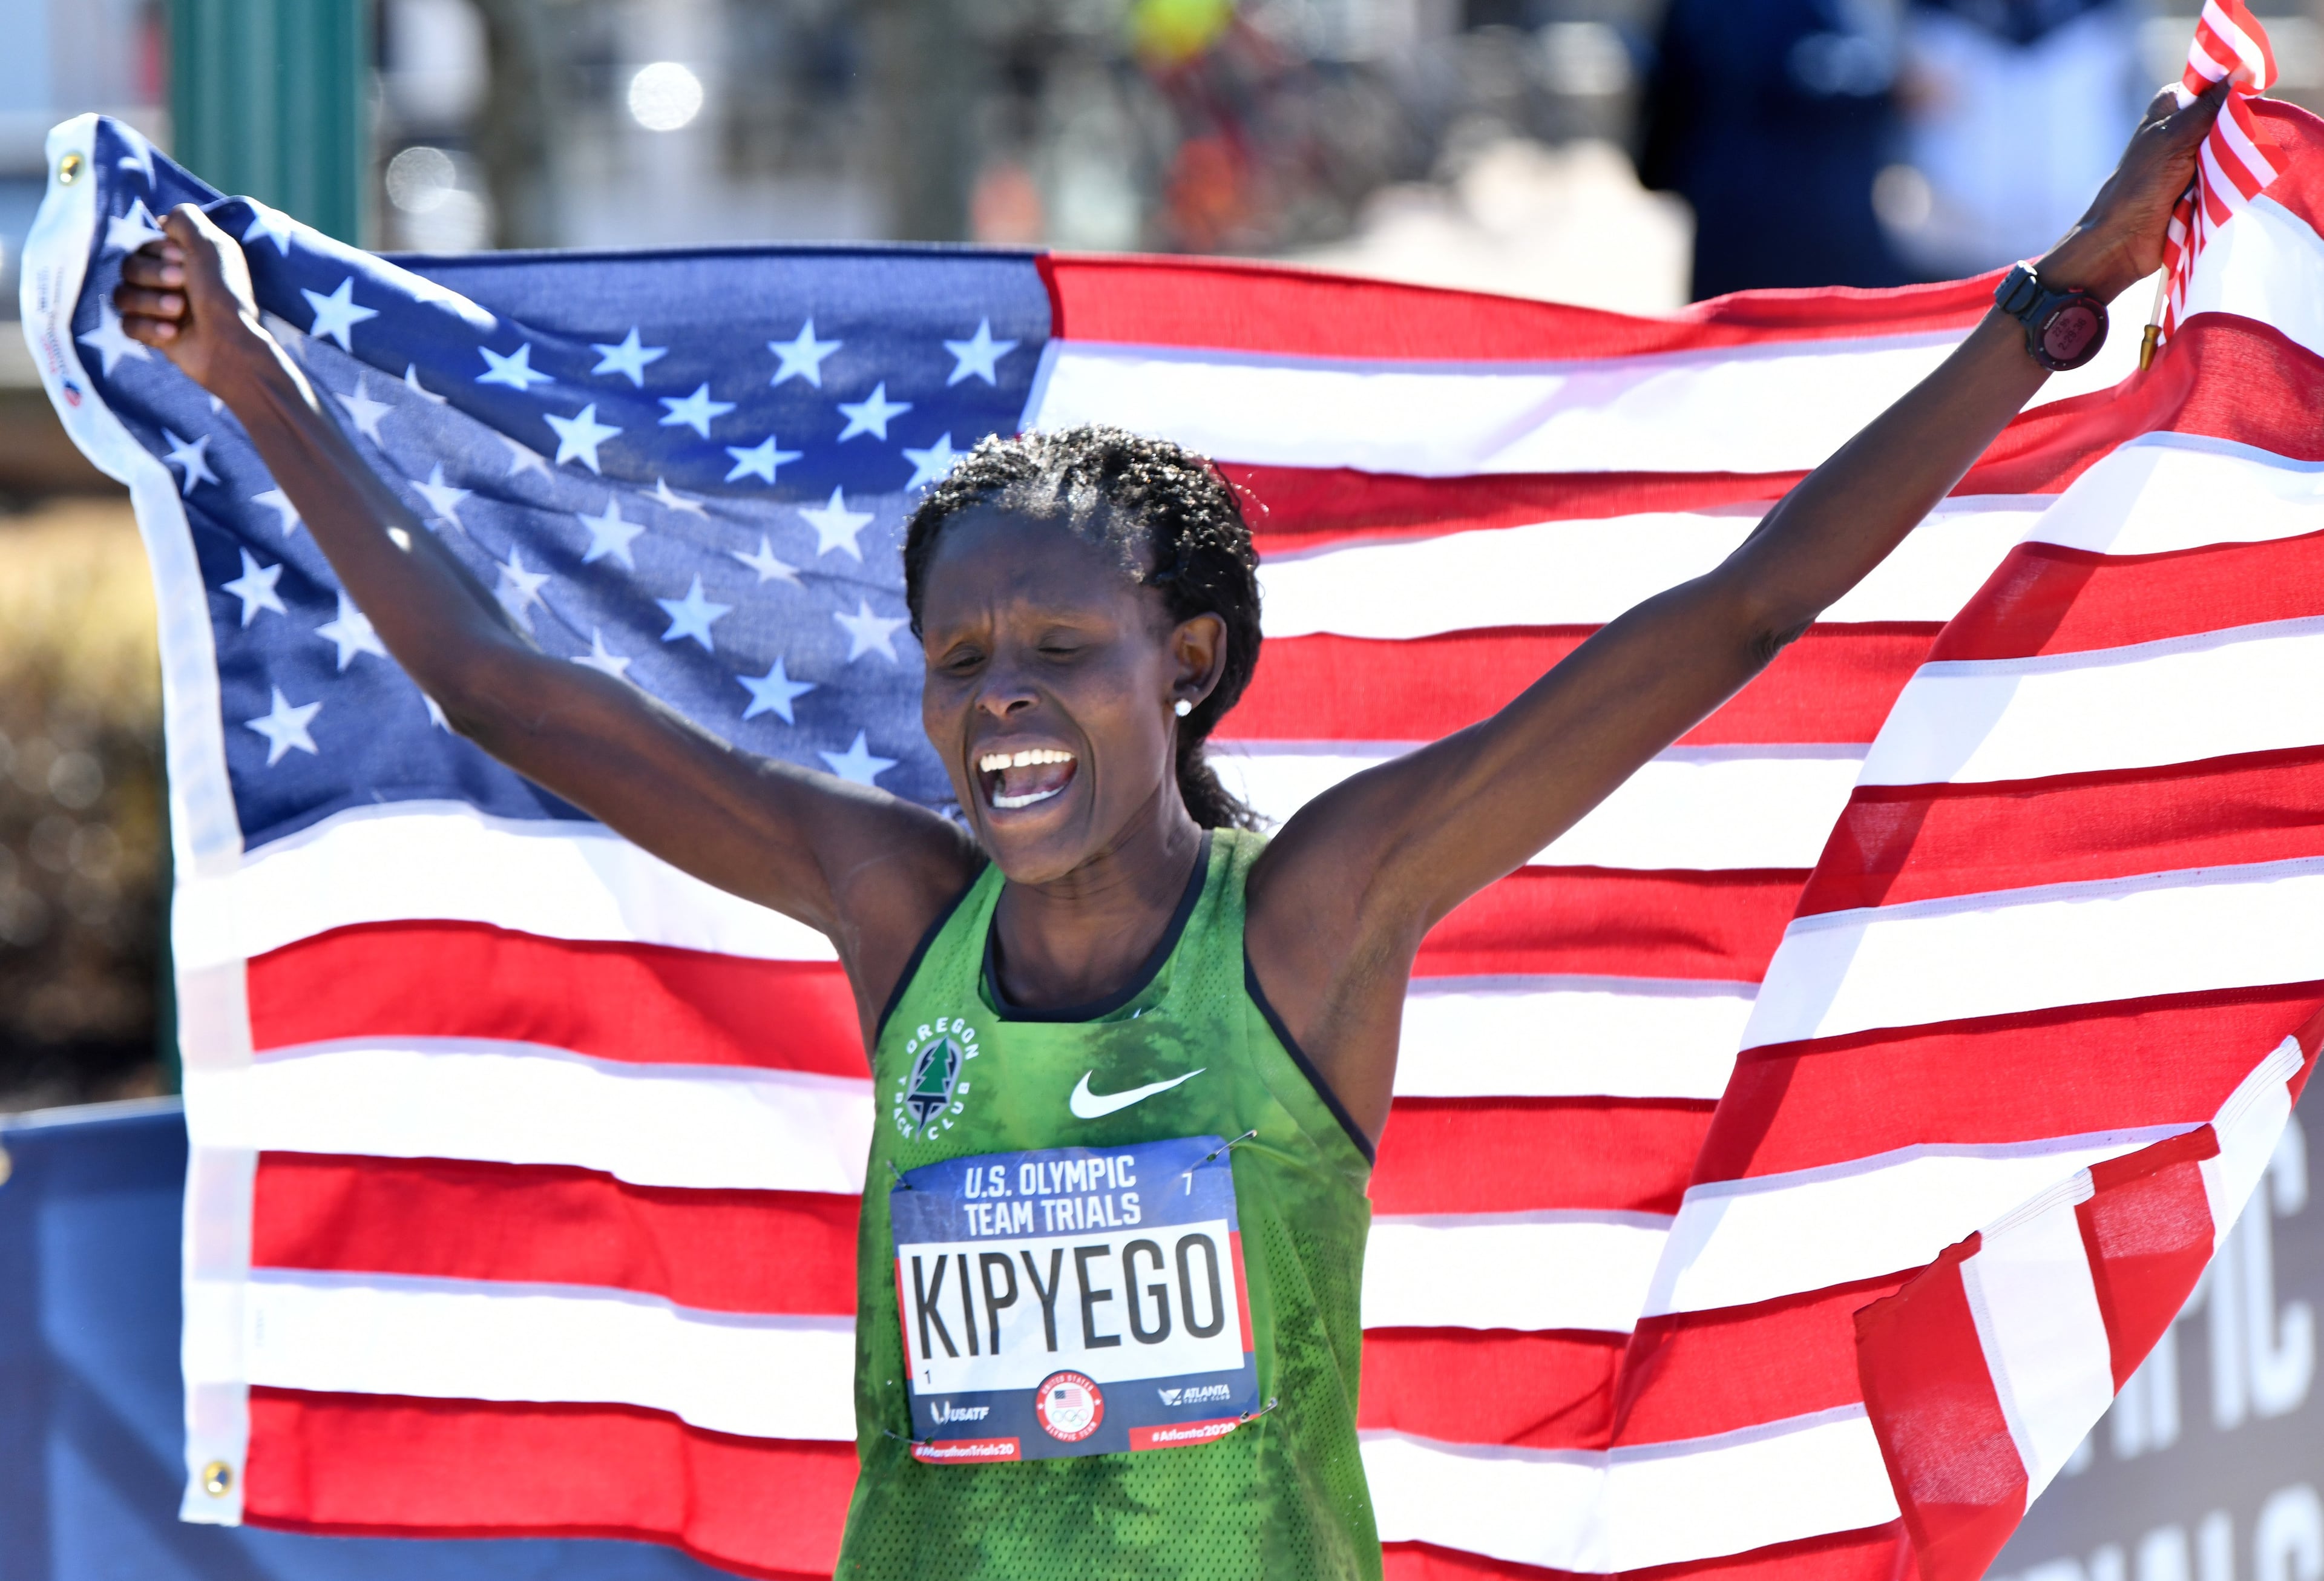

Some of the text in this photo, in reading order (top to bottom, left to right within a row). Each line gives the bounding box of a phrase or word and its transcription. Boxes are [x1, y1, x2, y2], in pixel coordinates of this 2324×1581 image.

[906, 1017, 979, 1060] OREGON
[893, 1075, 971, 1140] TRACK CLUB
[964, 1155, 1137, 1199] U.S. OLYMPIC
[1182, 1172, 1193, 1196] 7
[963, 1192, 1141, 1237] TEAM TRIALS
[911, 1232, 1225, 1360] KIPYEGO
[924, 1370, 931, 1385] 1
[1183, 1384, 1230, 1400] ATLANTA
[948, 1407, 990, 1422] USATF
[1152, 1422, 1236, 1442] #Atlanta2020
[915, 1443, 1015, 1458] #MarathonTrials20
